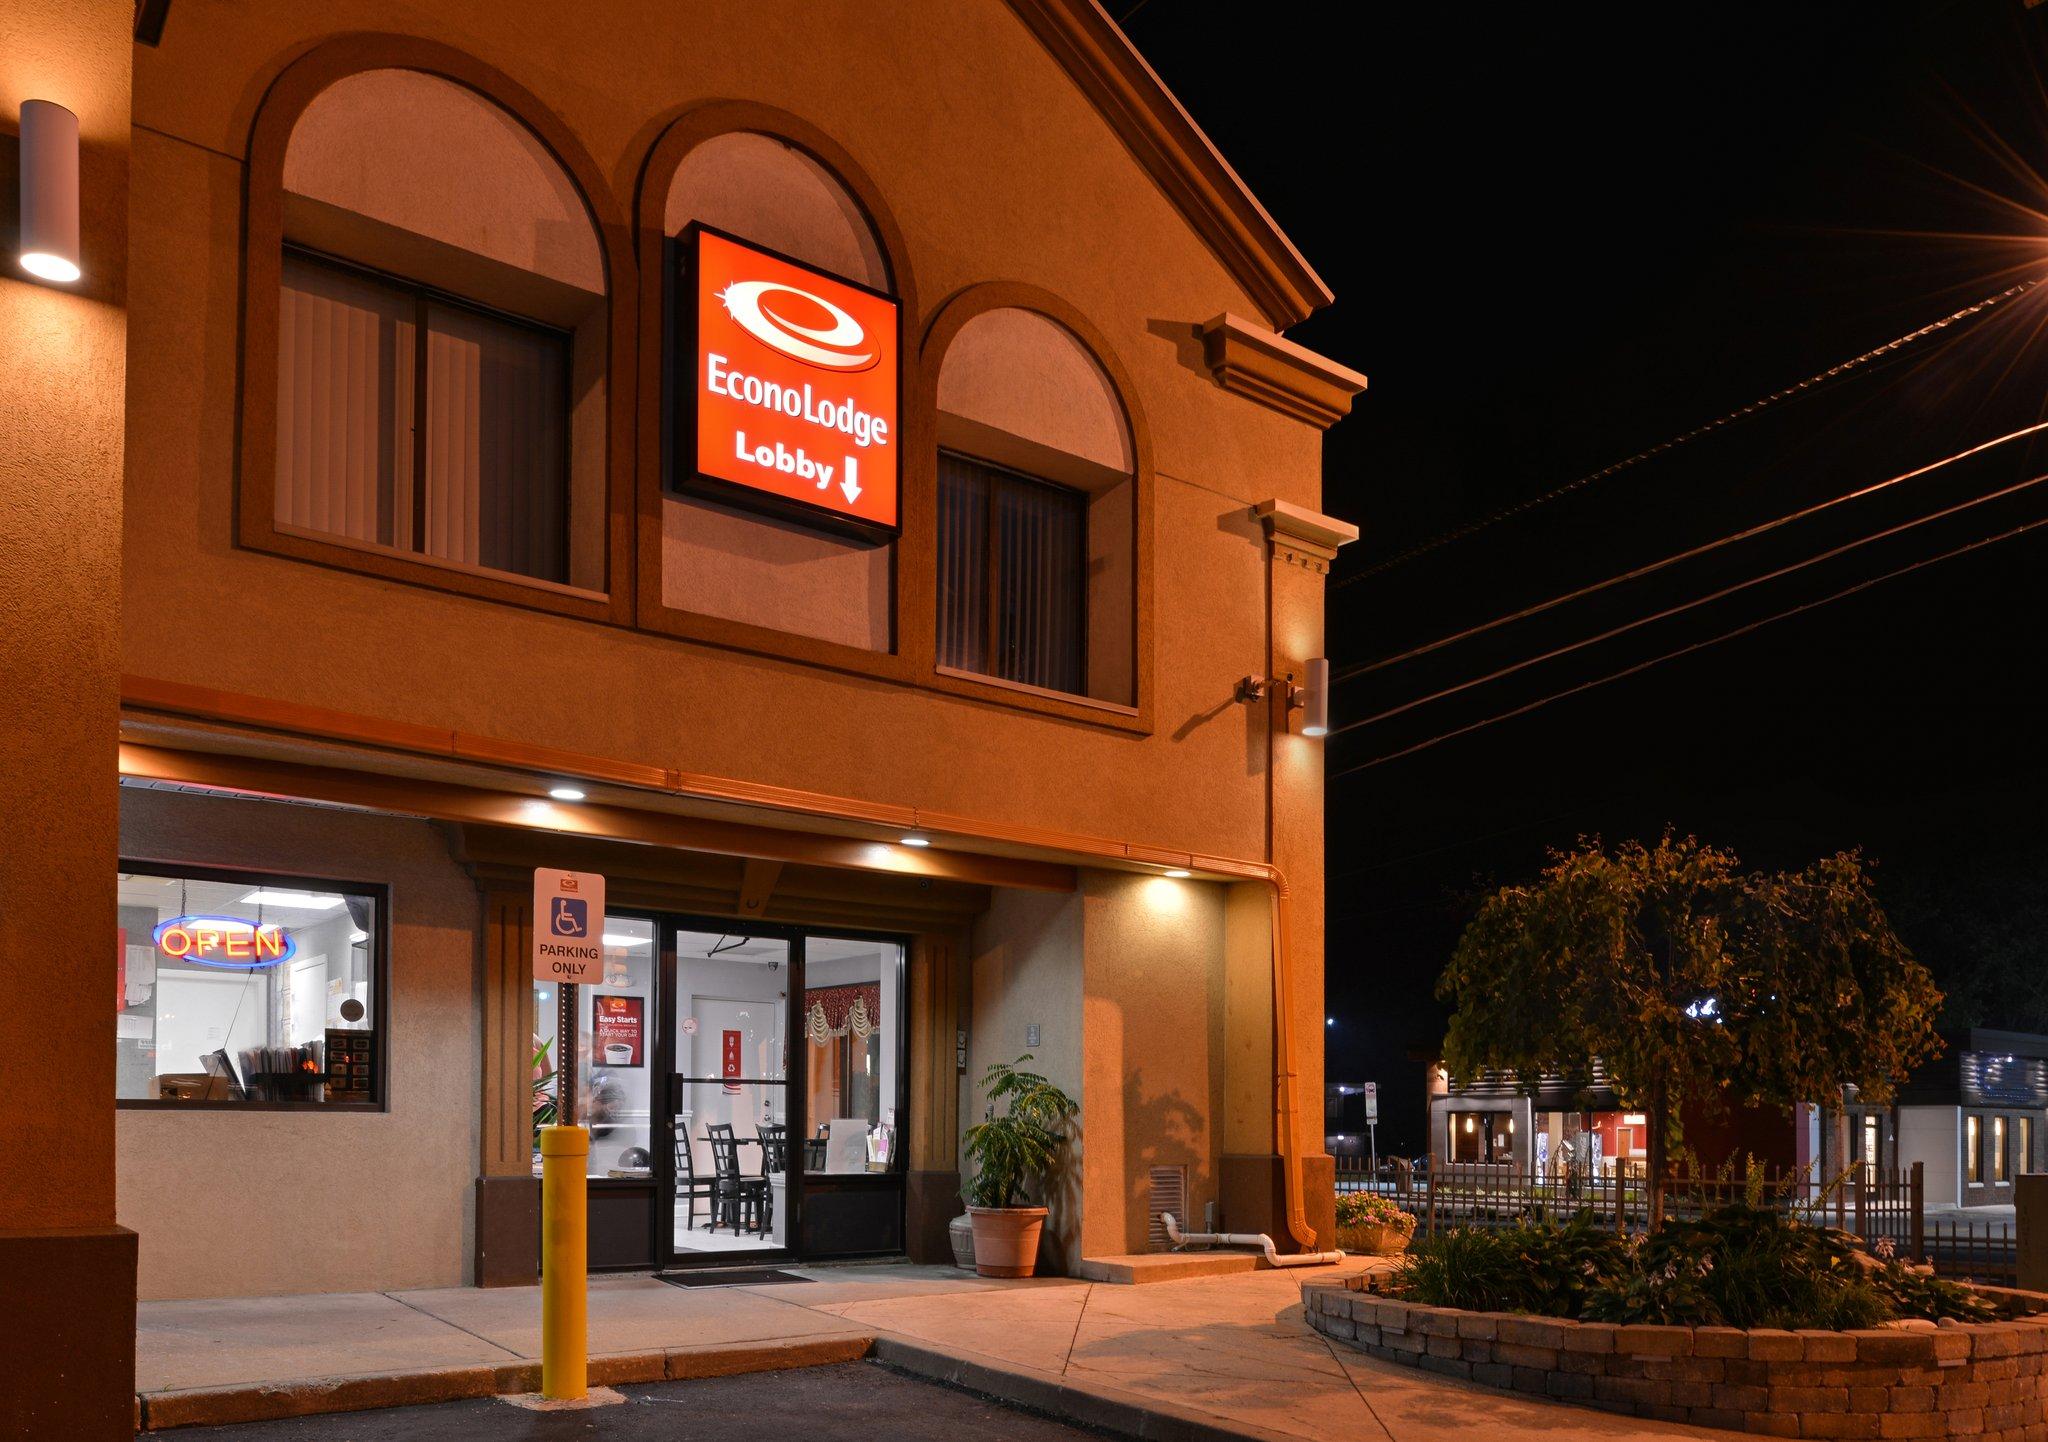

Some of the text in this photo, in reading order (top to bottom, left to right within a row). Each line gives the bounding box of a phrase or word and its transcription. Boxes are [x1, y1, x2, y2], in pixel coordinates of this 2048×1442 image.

[708, 353, 888, 448] EconoLodge
[736, 431, 834, 490] Lobby
[161, 928, 282, 957] OPEN
[540, 944, 599, 960] PARKING
[552, 962, 587, 975] ONLY
[599, 1015, 638, 1024] Easy Starts
